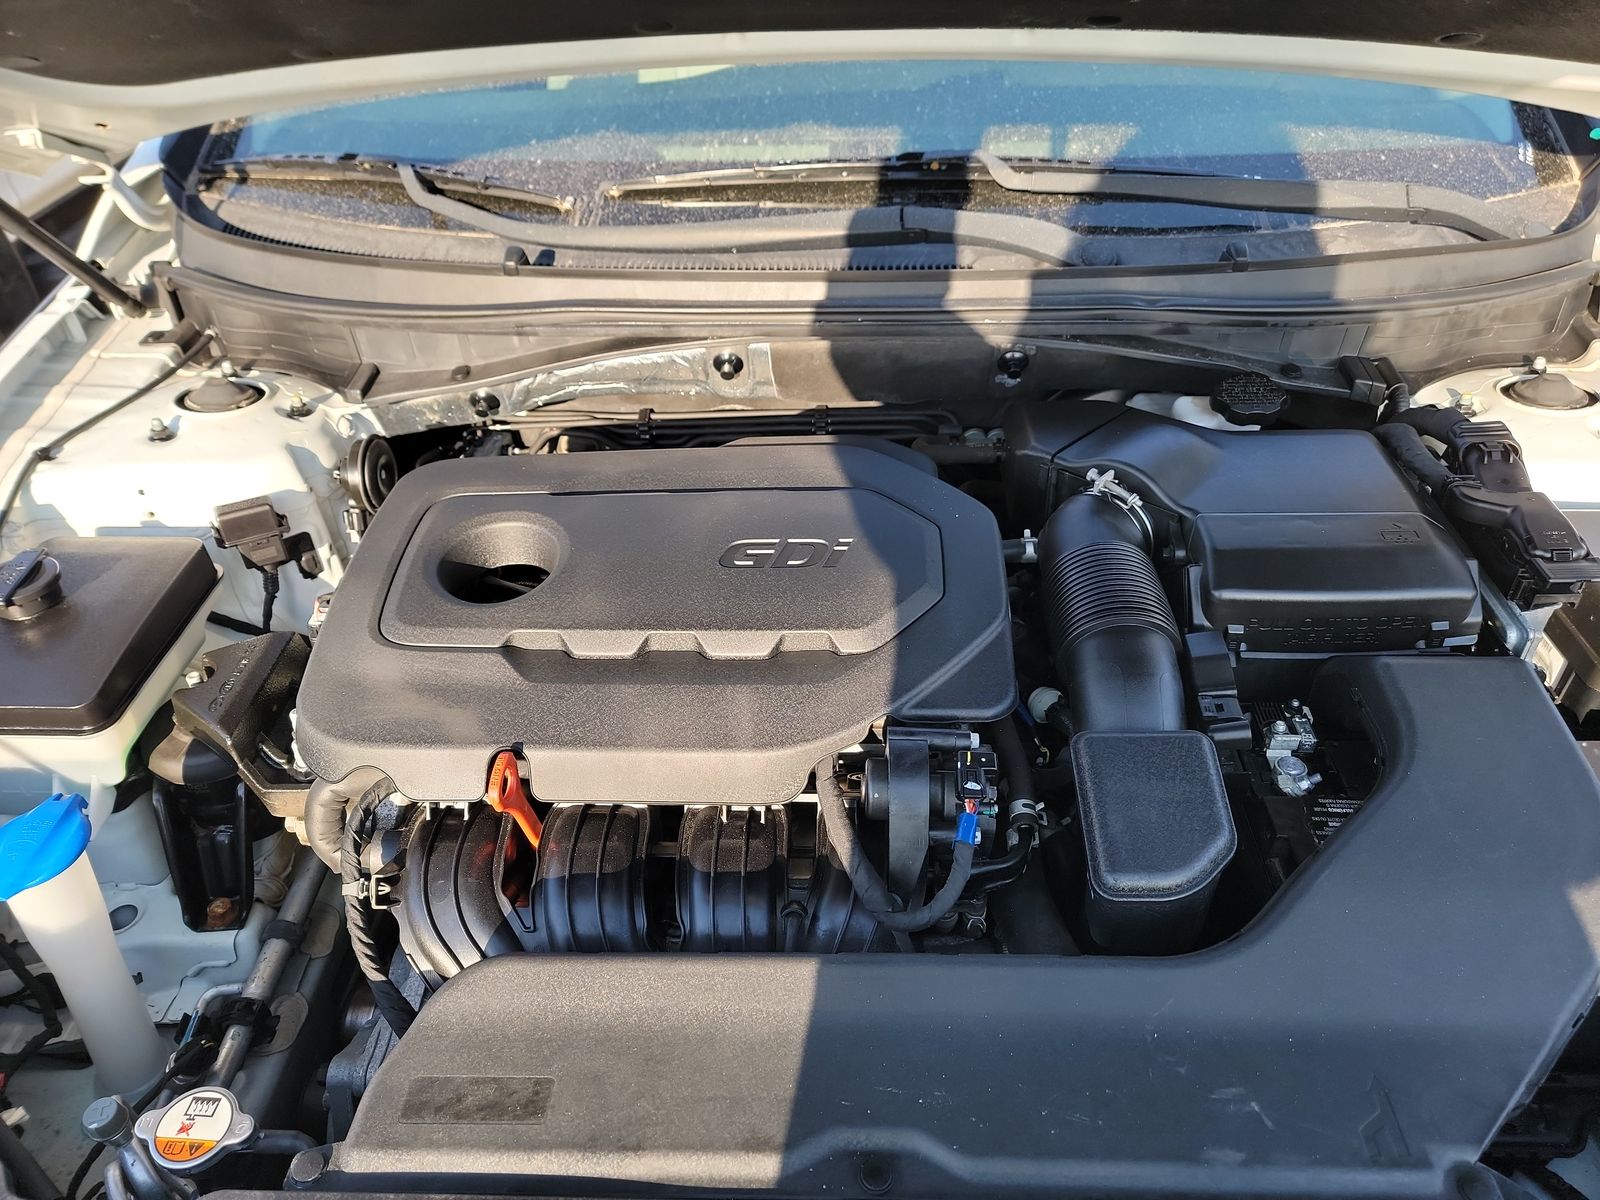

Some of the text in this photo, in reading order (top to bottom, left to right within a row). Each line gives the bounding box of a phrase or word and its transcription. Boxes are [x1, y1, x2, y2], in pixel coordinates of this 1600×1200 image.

[718, 538, 854, 569] GDi
[1246, 618, 1294, 631] PULL
[1300, 617, 1343, 630] OUT
[1375, 616, 1427, 629] OPEN
